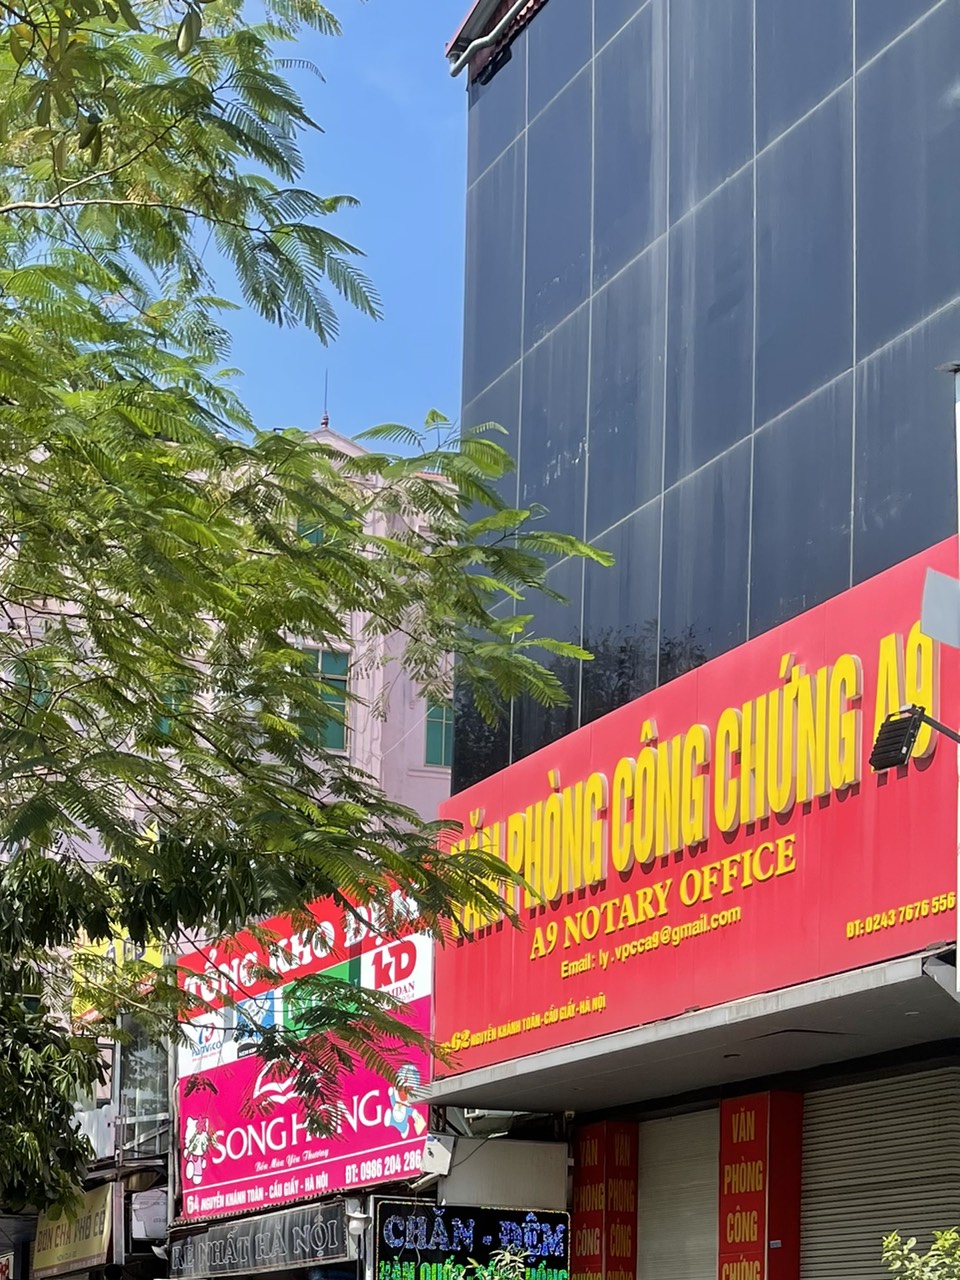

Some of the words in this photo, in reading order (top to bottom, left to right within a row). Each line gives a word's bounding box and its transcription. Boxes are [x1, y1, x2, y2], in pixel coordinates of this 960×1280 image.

[507, 769, 607, 916] PHÒNG
[611, 720, 709, 872] CÔNG
[714, 652, 862, 832] CHỨNG
[871, 620, 939, 774] A9
[530, 922, 558, 960] A9
[563, 879, 673, 948] NOTARY
[680, 834, 797, 906] OFFICE
[865, 909, 896, 933] 0243
[898, 899, 929, 922] 7676
[931, 891, 957, 913] 556
[269, 920, 335, 973] KHO
[561, 952, 596, 979] Email:
[451, 1029, 471, 1052] 62
[732, 1106, 755, 1144] VĂN
[360, 1159, 382, 1182] 0986
[384, 1154, 402, 1177] 204
[403, 1149, 422, 1173] 286
[724, 1156, 763, 1195] PHÒNG
[187, 1194, 200, 1215] 64
[199, 1226, 251, 1267] NHẤT
[255, 1223, 288, 1260] HÀ
[292, 1214, 339, 1257] NỘI
[383, 1206, 476, 1252] CHĂN
[498, 1211, 566, 1263] ĐỆM
[576, 1223, 600, 1257] CÔNG
[610, 1218, 632, 1258] CÔNG
[726, 1205, 758, 1244] CÔNG
